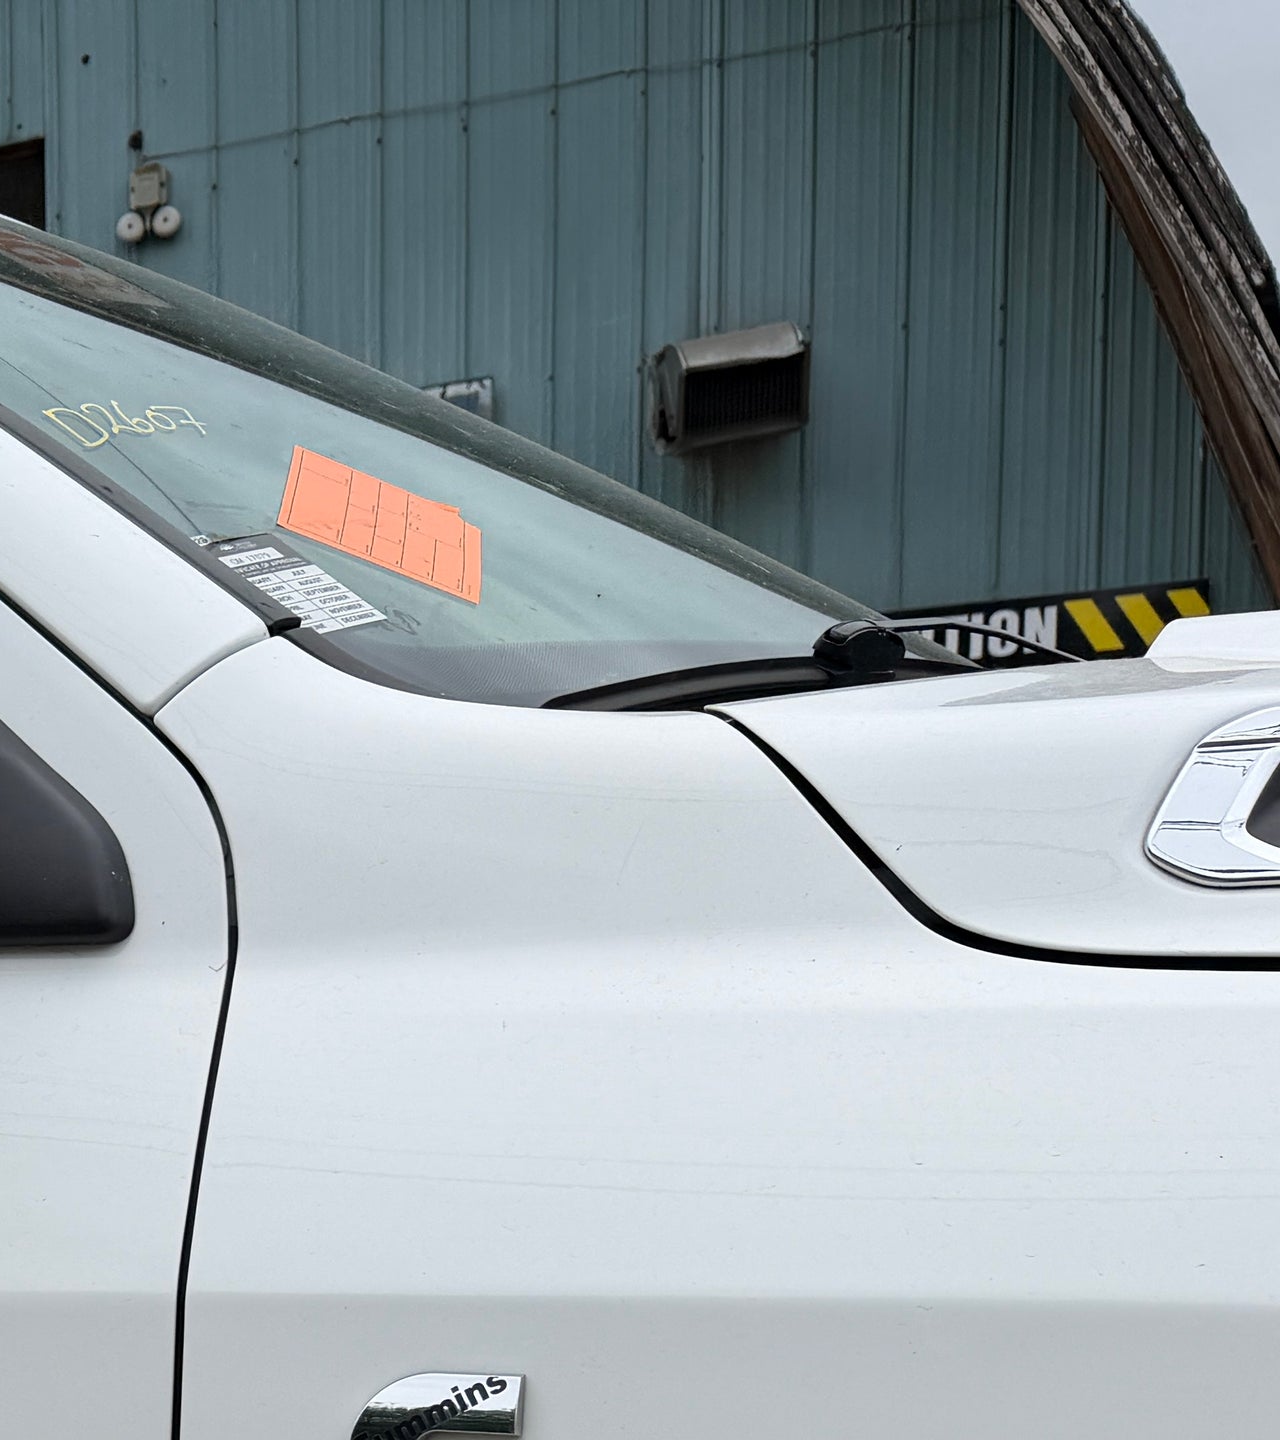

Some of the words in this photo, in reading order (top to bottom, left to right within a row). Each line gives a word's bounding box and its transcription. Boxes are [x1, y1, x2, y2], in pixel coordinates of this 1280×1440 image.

[42, 400, 207, 449] D2607
[298, 577, 324, 586] AUGUST
[303, 585, 342, 597] SEPTEMBER
[319, 594, 351, 605] OCTOBER
[329, 603, 365, 615] NOVEMBER
[340, 612, 377, 623] DECEMBER
[920, 604, 1058, 660] TION
